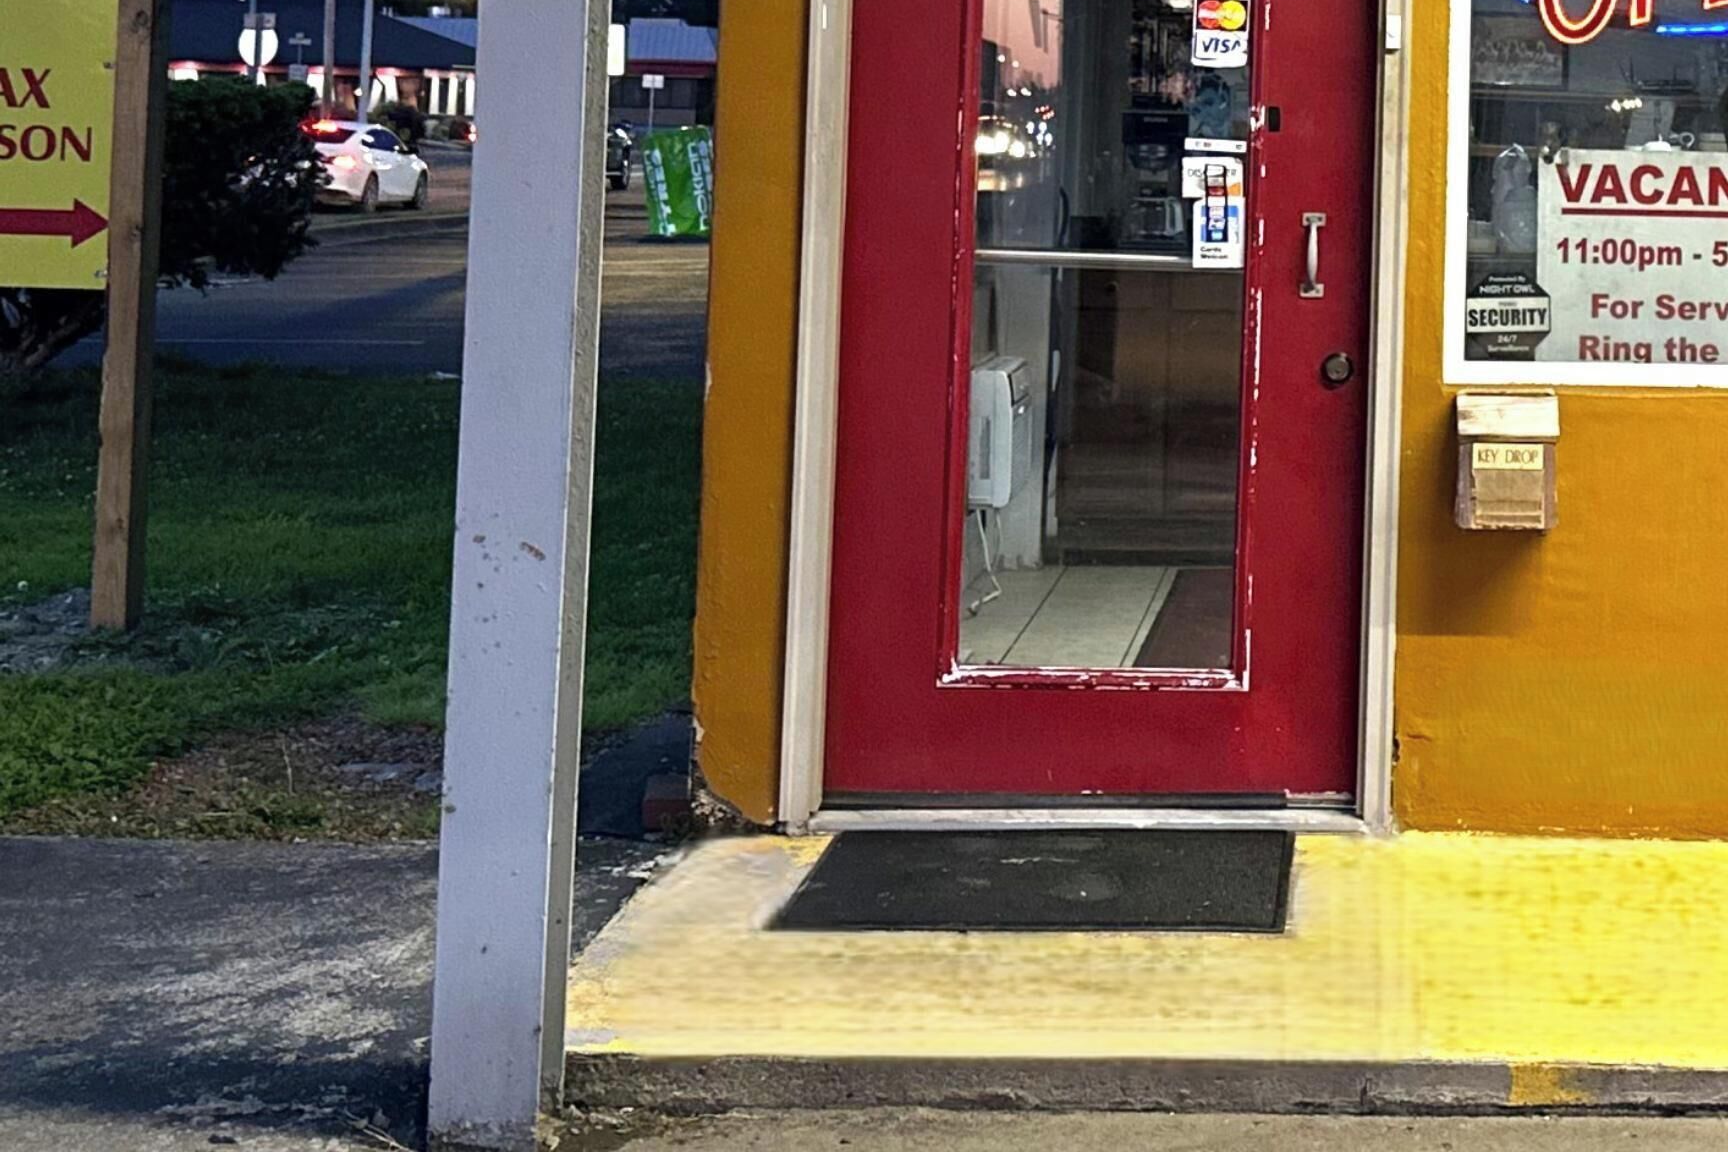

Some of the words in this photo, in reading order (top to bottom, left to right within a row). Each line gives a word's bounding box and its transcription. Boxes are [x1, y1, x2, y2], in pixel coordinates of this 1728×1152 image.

[1557, 237, 1682, 271] 11:00pm
[1468, 308, 1547, 327] SECURITY
[1591, 294, 1644, 319] For
[1579, 335, 1652, 363] Ring
[1664, 337, 1719, 363] the
[1477, 449, 1499, 463] KEY
[1505, 450, 1539, 464] DROP
